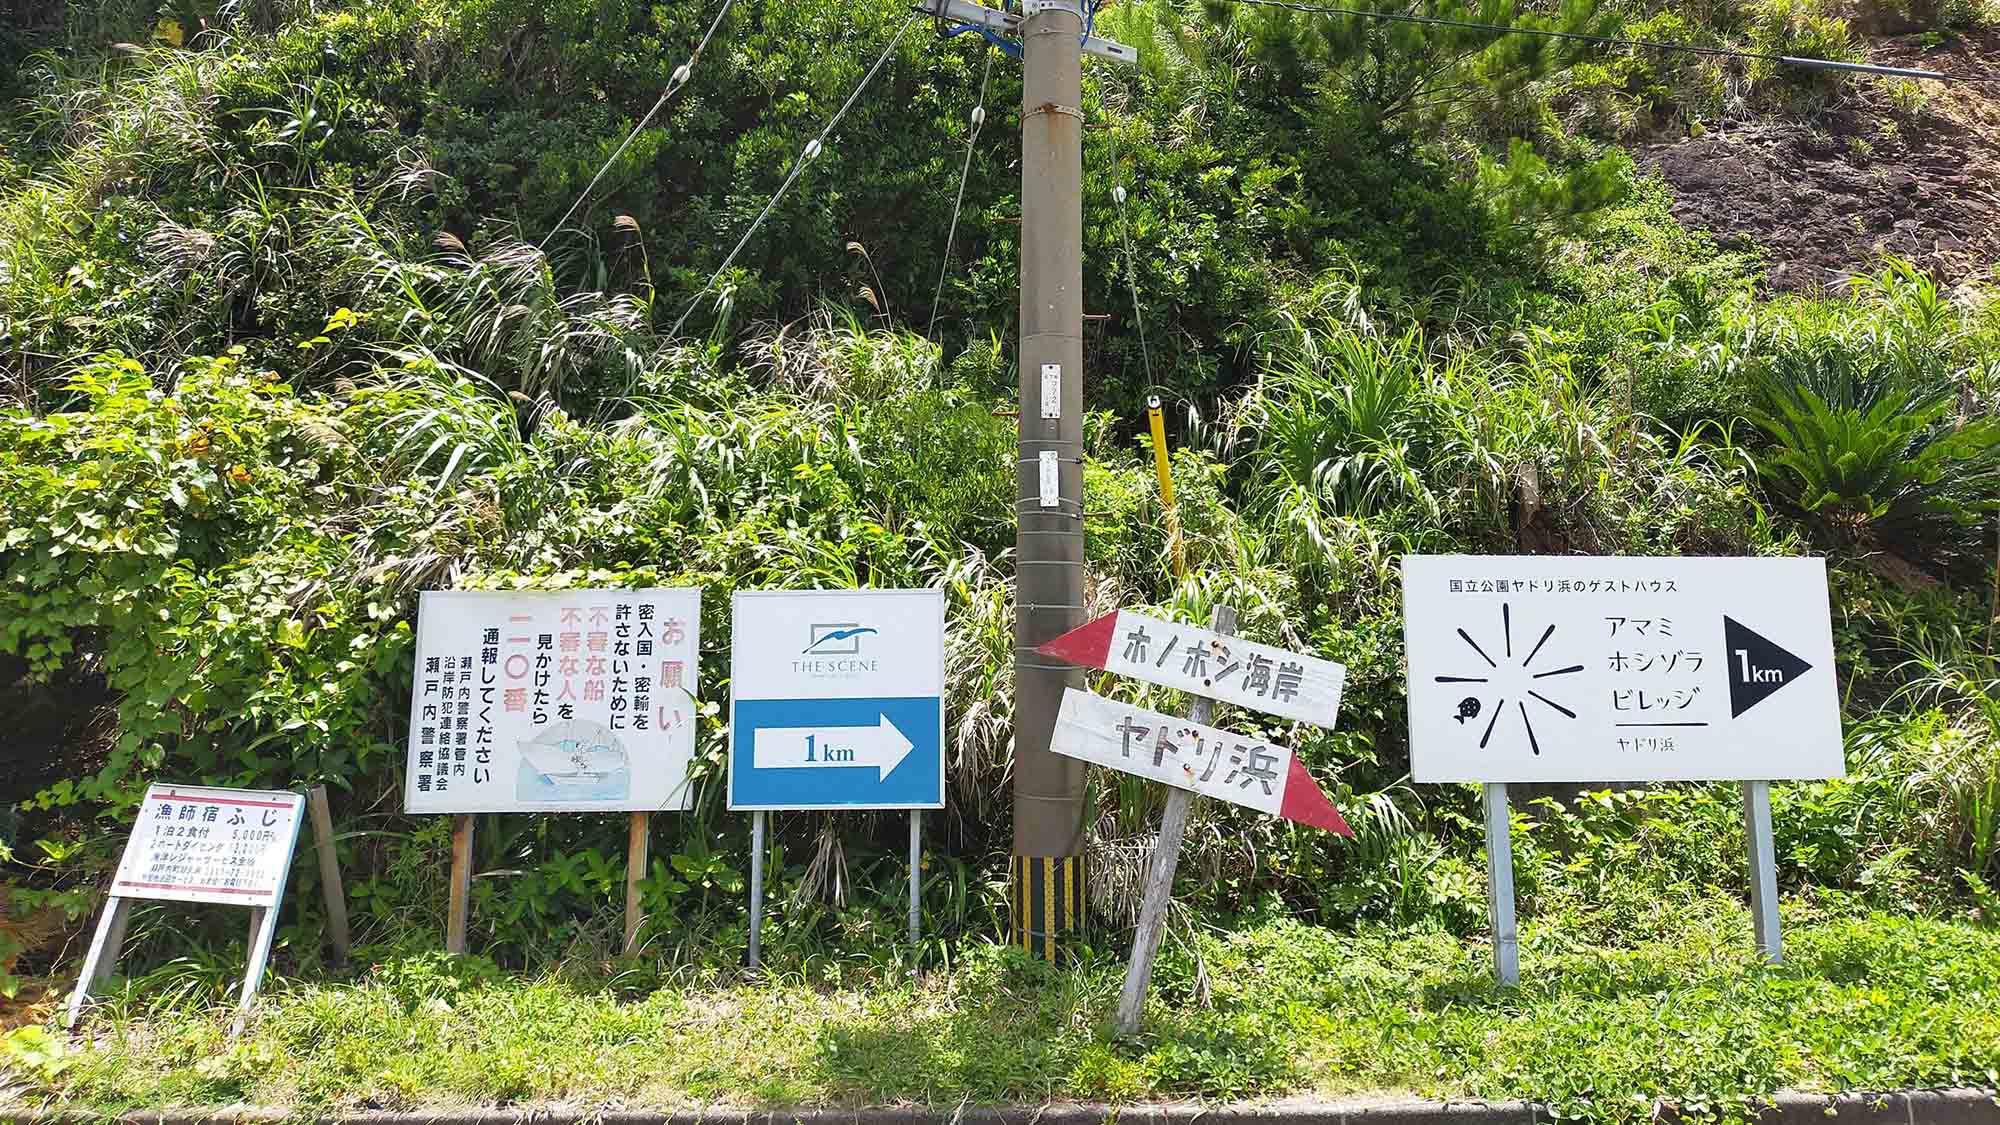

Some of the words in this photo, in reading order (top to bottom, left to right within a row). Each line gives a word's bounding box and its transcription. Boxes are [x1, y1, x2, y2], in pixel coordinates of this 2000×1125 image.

[1449, 579, 1678, 593] 国立公園ヤドリ浜のゲストハウス
[1604, 617, 1673, 638] アマミ
[532, 633, 553, 725] 見かけたら
[556, 606, 582, 720] 不審な人を
[583, 606, 609, 702] 不審な船
[609, 603, 633, 731] 許さないために
[631, 603, 655, 731] 密入国・密輸を
[657, 617, 688, 732] お願い
[791, 660, 824, 673] THE
[827, 660, 879, 673] SCENE
[1122, 625, 1304, 703] ホノホシ海岸
[1608, 649, 1704, 673] ホシゾラ
[1613, 686, 1701, 711] ビレッジ
[417, 656, 441, 792] 瀬戸内警察署
[435, 655, 456, 791] 沿岸防犯連絡協議会
[473, 627, 500, 784] 通報してください
[1616, 737, 1676, 752] ヤドリ浜
[1116, 716, 1279, 796] ヤドリ浜
